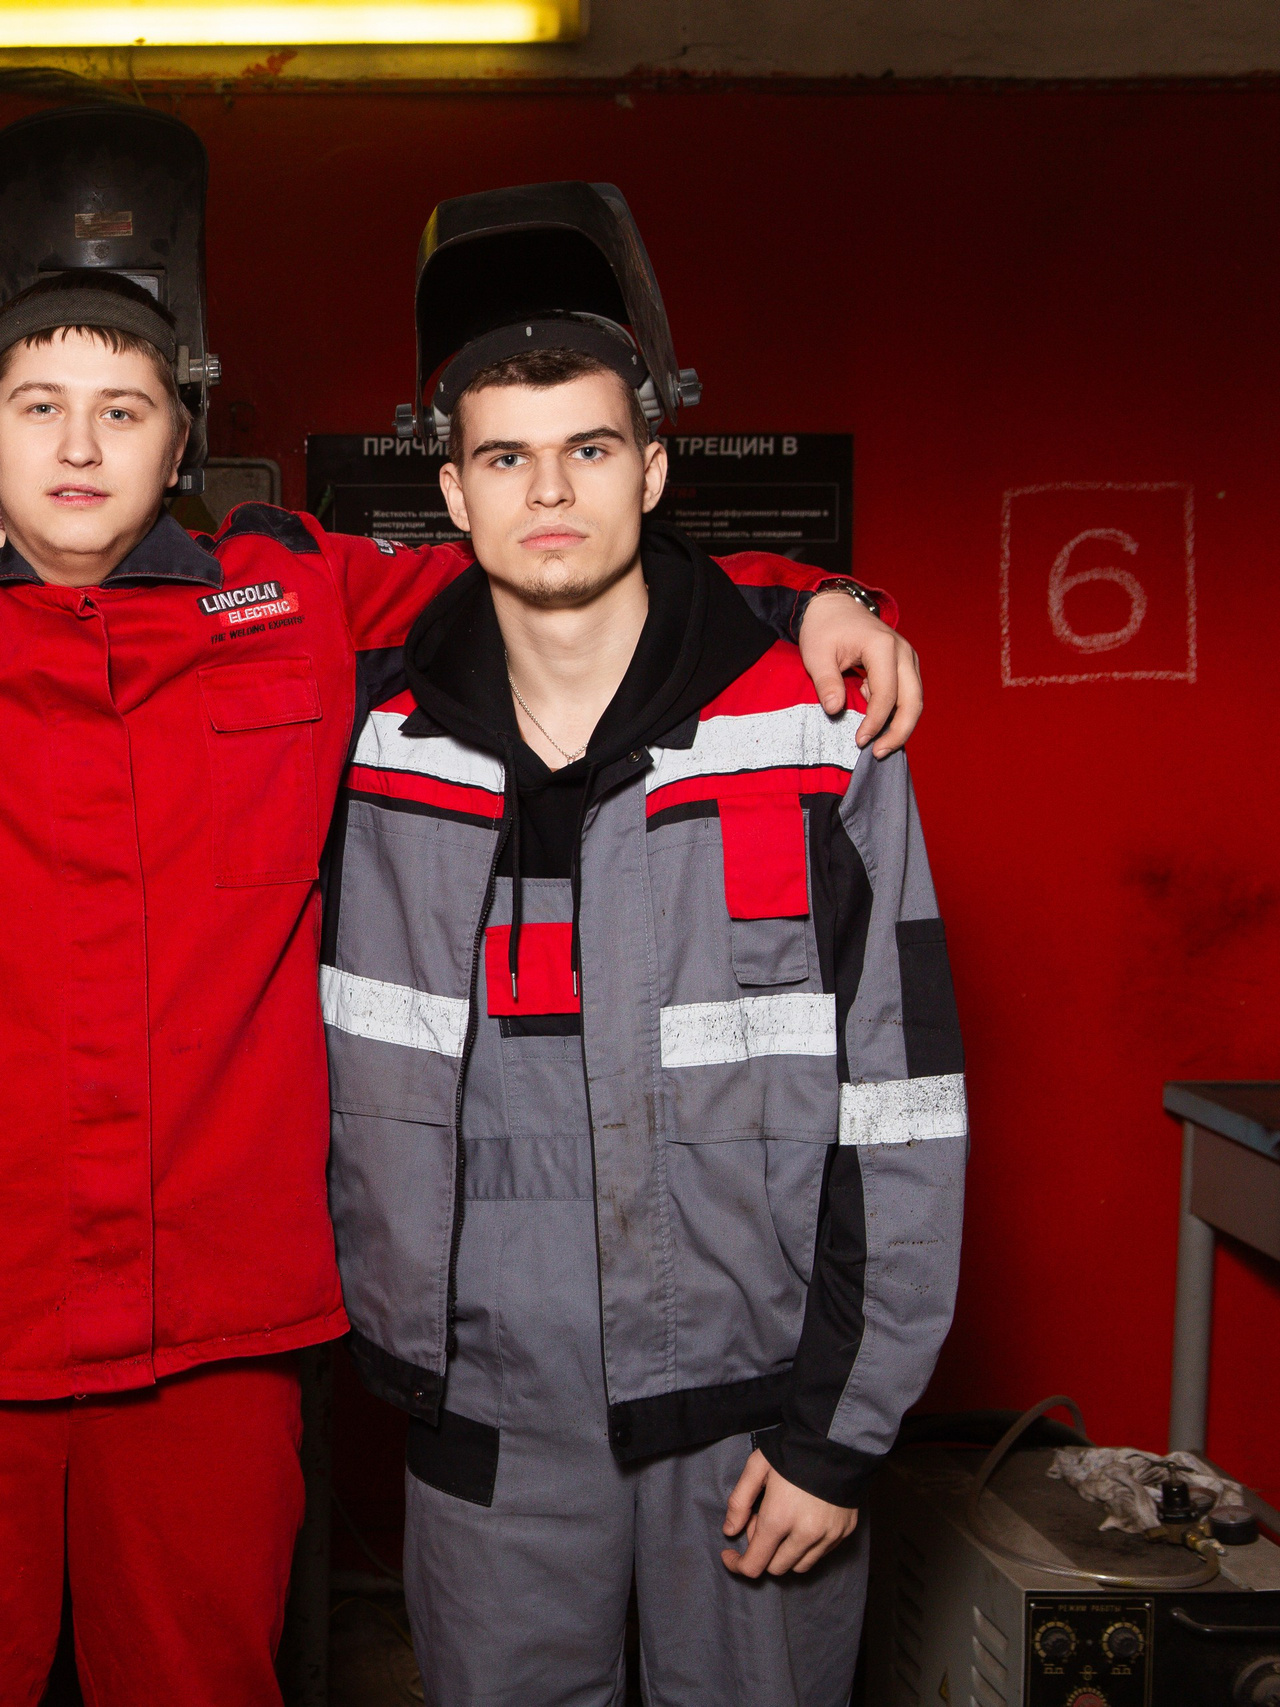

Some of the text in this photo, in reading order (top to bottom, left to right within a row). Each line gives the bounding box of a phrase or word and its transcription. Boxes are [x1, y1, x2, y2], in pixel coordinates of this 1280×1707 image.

[676, 437, 775, 460] ТРЕЩИН
[781, 436, 799, 456] В
[418, 511, 450, 520] сварно
[201, 582, 279, 613] LINCOLN
[1048, 527, 1148, 655] 6
[228, 600, 291, 624] ELECTRIC
[210, 634, 227, 645] THE
[229, 625, 267, 640] WELDING
